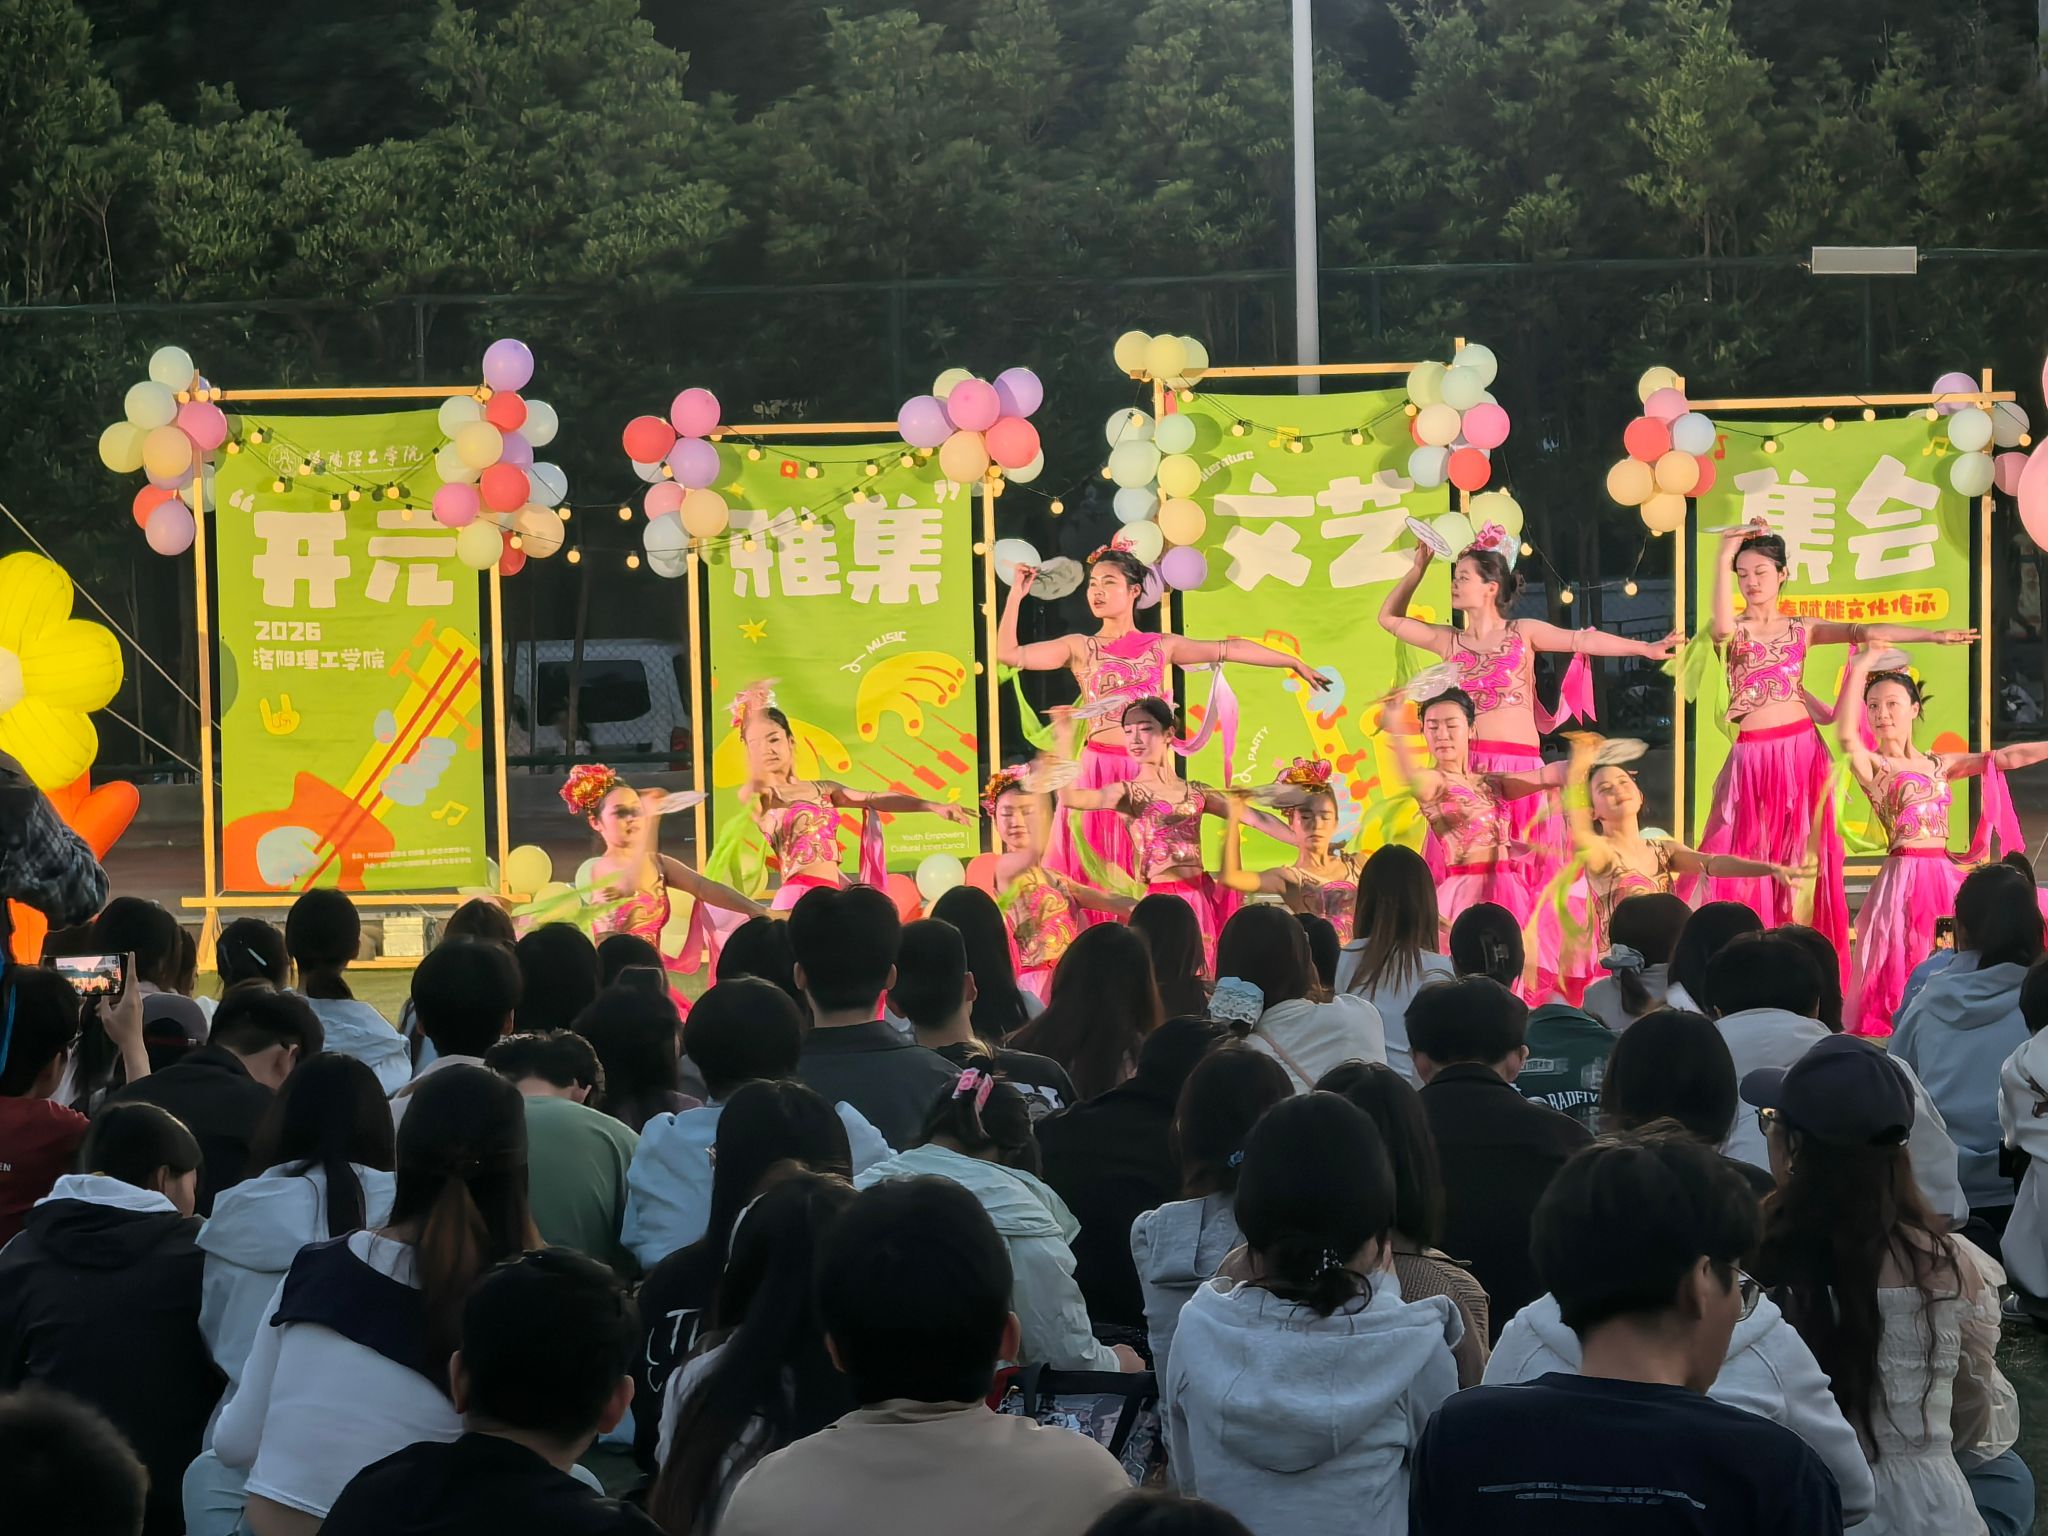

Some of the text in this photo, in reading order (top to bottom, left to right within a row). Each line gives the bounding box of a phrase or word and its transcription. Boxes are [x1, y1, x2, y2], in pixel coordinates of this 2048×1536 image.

[1200, 450, 1255, 482] iterature
[1212, 468, 1416, 592] 文艺
[1733, 455, 1941, 585] 集会
[254, 620, 321, 641] 2026
[865, 630, 907, 655] MUSIC
[253, 647, 385, 671] 洛阳理工学院
[1247, 726, 1269, 761] PARTY
